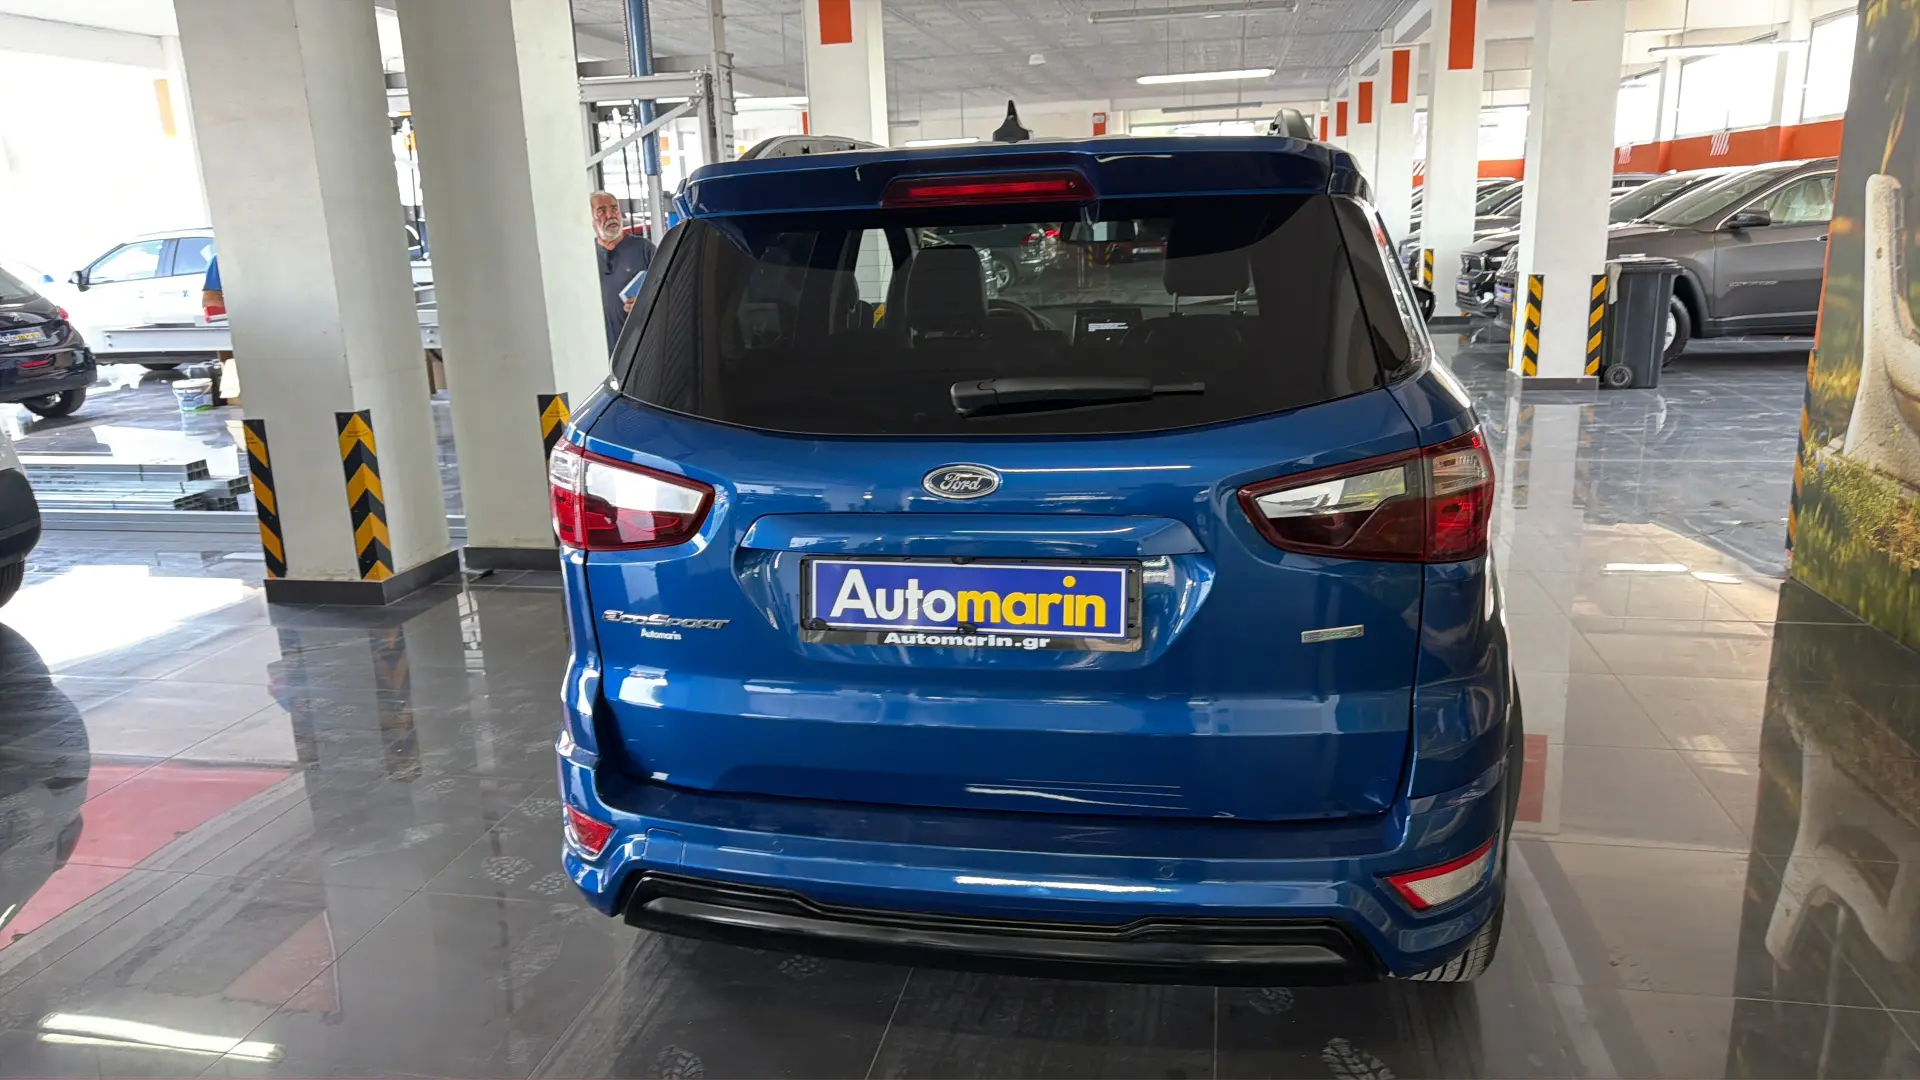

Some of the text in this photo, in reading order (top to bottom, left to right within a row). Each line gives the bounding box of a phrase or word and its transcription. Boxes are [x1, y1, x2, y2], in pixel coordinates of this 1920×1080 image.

[940, 472, 982, 491] Ford
[829, 568, 1106, 628] Automarin
[640, 627, 682, 641] Automarin
[883, 631, 1050, 650] Automarin.gr
